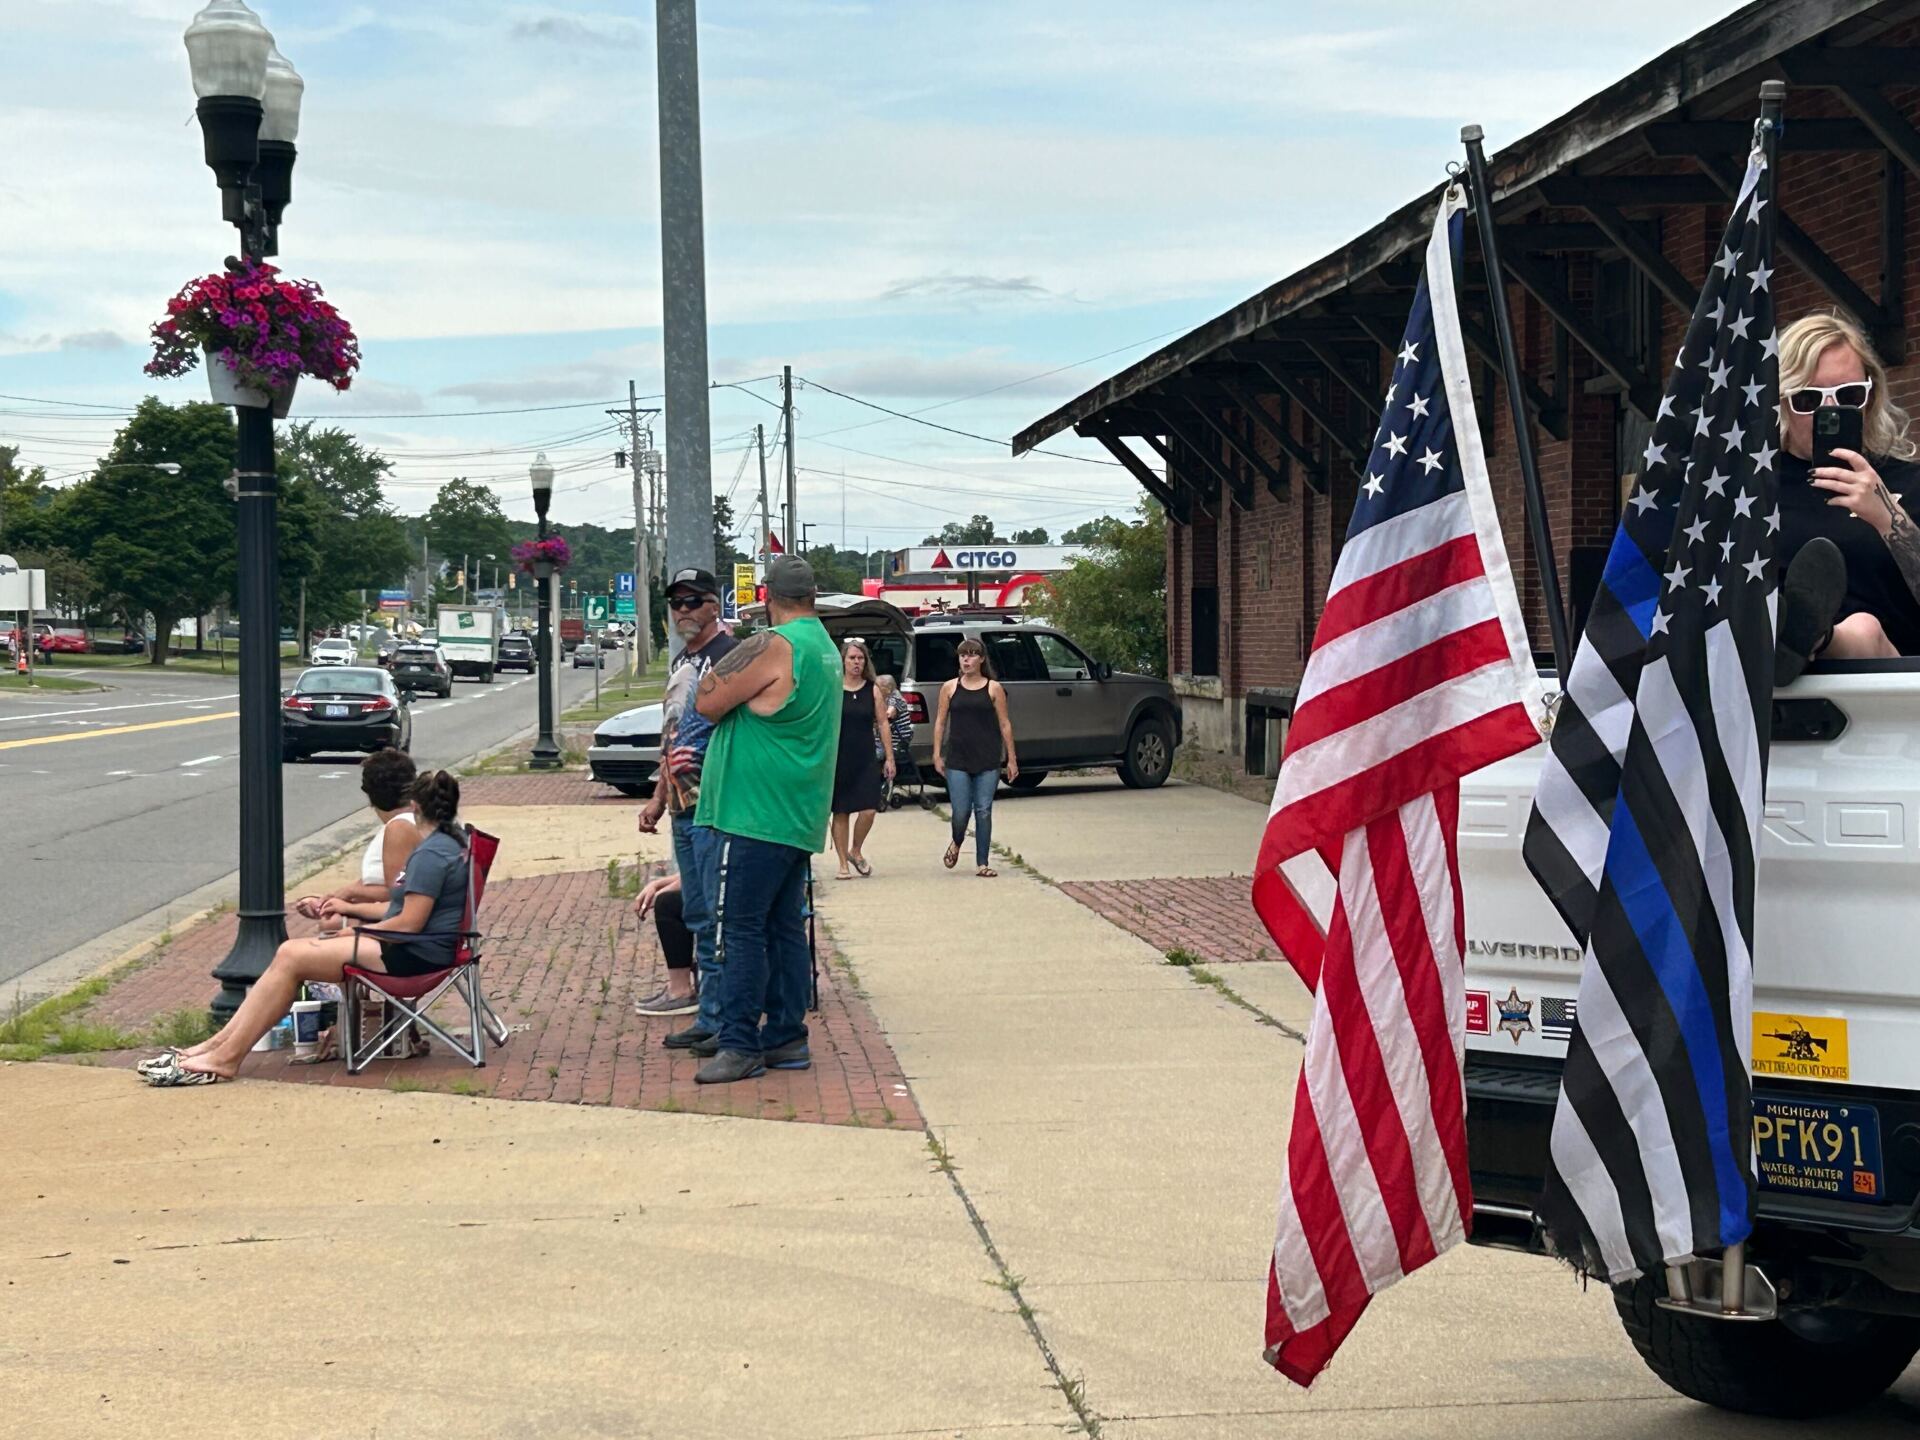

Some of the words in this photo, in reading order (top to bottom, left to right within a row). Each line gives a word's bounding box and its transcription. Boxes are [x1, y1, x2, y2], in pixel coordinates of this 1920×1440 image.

[956, 551, 1017, 568] CITGO
[620, 575, 633, 592] H
[1468, 939, 1583, 962] LVERAD
[1797, 1063, 1808, 1075] ON
[1809, 1064, 1820, 1076] MY
[1767, 1105, 1829, 1119] MICHIGAN
[1753, 1115, 1864, 1167] PFK91
[1761, 1162, 1796, 1175] WATER
[1803, 1166, 1844, 1180] WINTER
[1767, 1174, 1839, 1192] WONDERLAND
